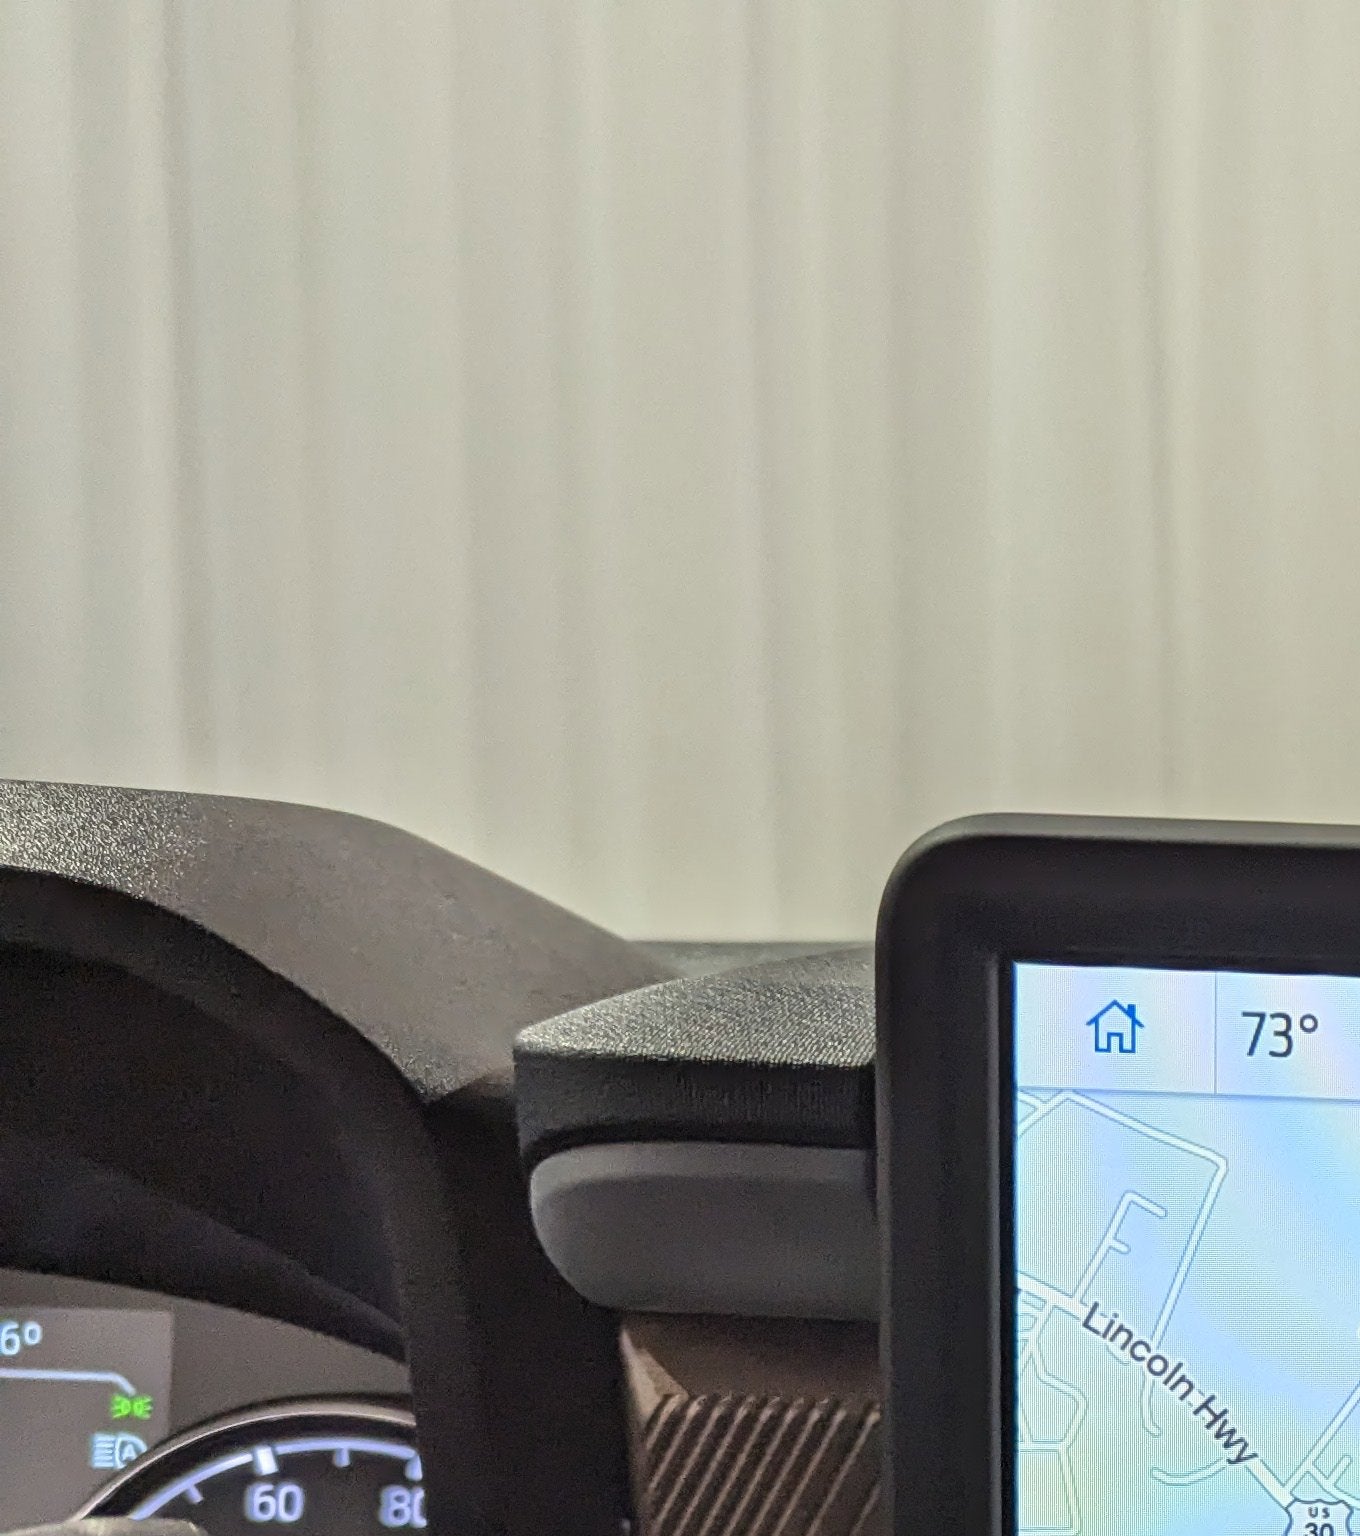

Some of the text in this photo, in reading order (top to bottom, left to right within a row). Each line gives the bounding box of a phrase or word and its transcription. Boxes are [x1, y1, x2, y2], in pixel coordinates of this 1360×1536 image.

[1241, 1010, 1319, 1058] 73°
[1081, 1302, 1259, 1468] Lincoln Hwy
[246, 1481, 304, 1523] 60
